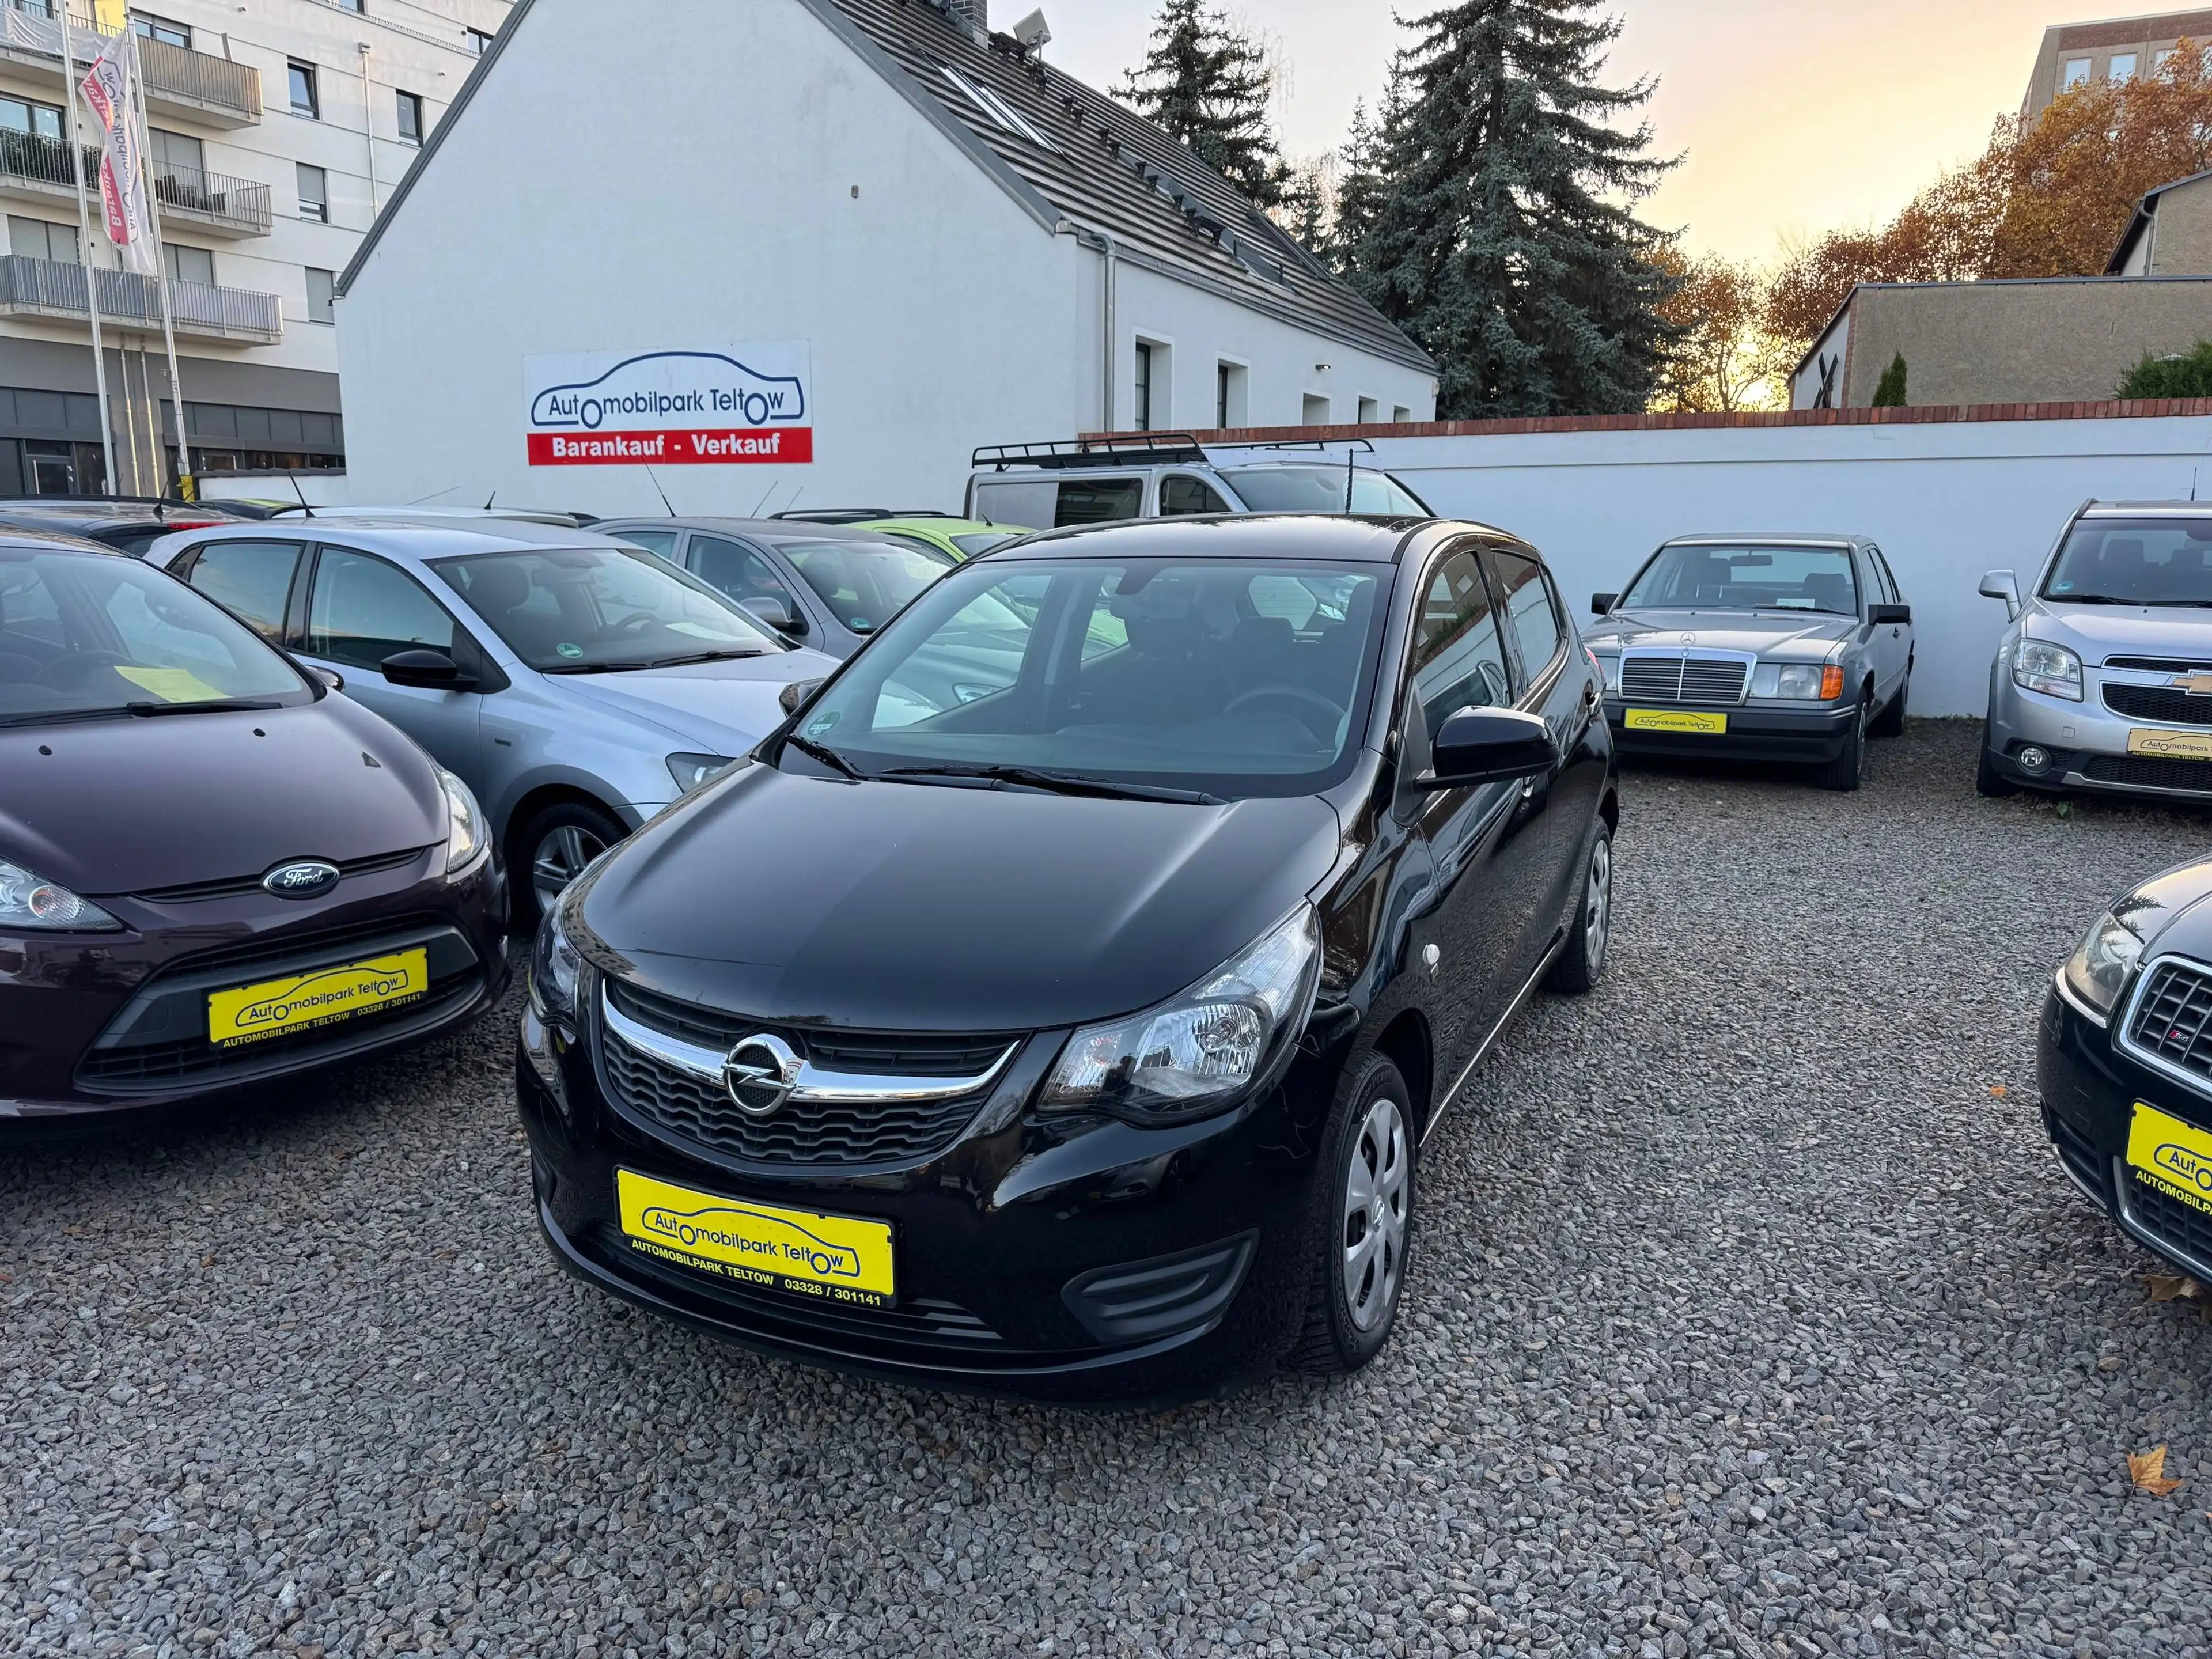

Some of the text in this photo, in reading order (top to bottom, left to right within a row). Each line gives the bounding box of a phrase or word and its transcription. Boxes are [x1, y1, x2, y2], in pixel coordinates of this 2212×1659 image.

[551, 435, 665, 457] Barankauf
[691, 433, 781, 455] Verkauf
[2132, 751, 2180, 759] AUTOMOBILPARK
[283, 868, 324, 888] Ford
[222, 1023, 311, 1048] AUTOMOBILPARK
[312, 1011, 350, 1028] TELTOW
[357, 1002, 384, 1017] 03328
[391, 993, 422, 1008] 301141
[631, 1238, 724, 1274] AUTOMOBILPARK
[725, 1266, 774, 1285] TELTOW
[784, 1279, 823, 1296] 03328
[835, 1288, 881, 1306] 301141
